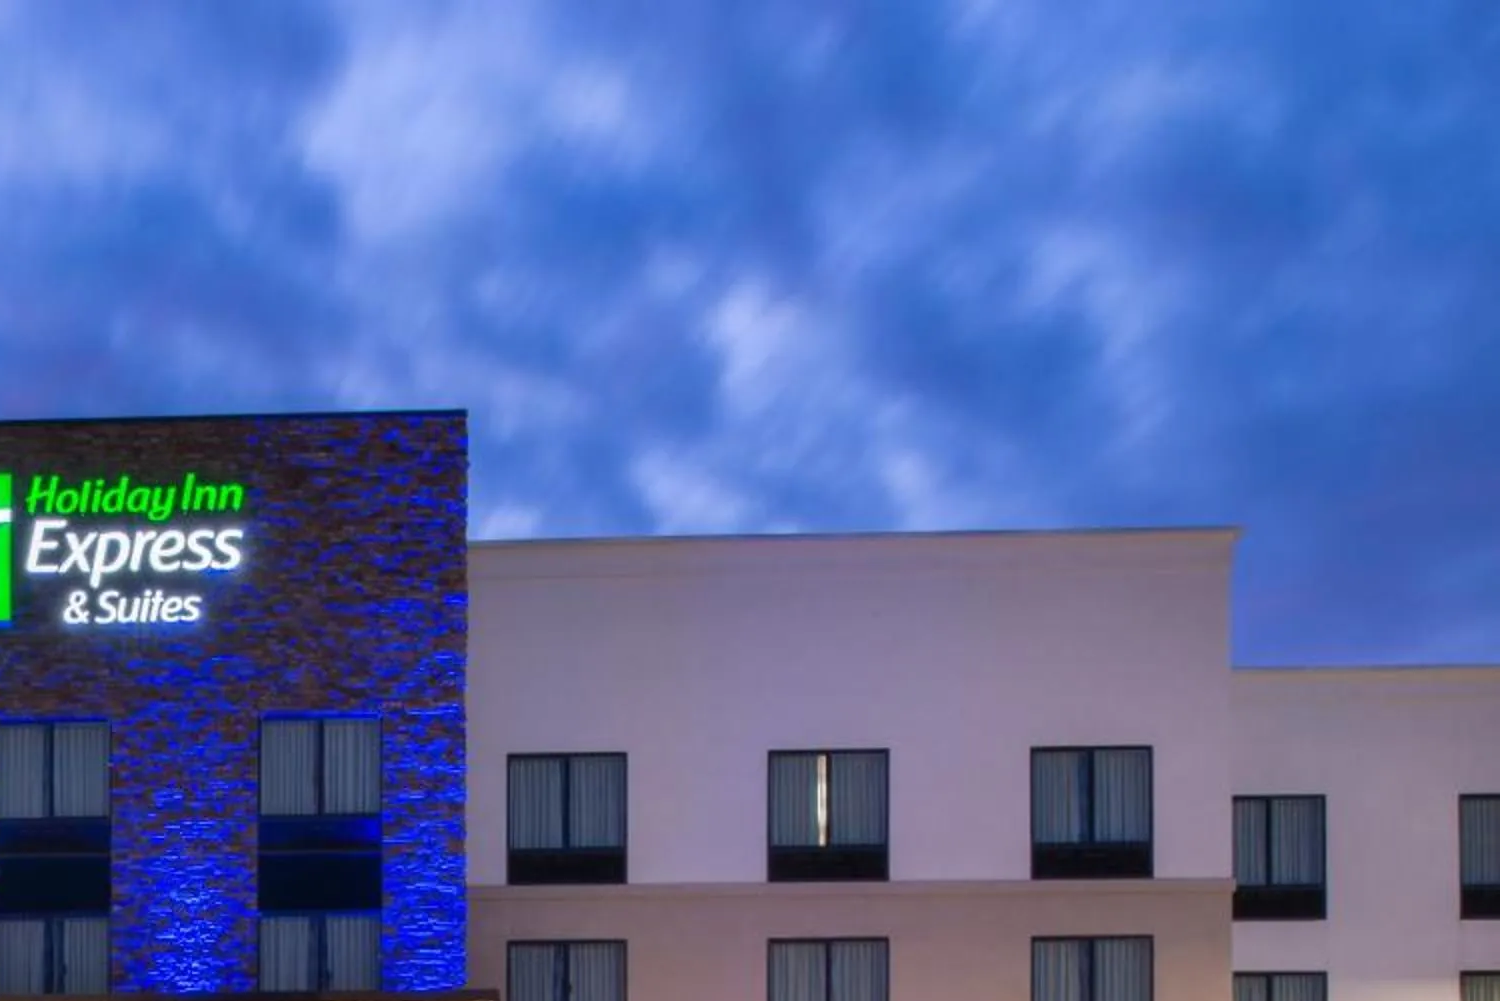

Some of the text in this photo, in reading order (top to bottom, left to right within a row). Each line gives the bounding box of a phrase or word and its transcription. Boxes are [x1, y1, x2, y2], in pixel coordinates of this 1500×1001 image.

[25, 473, 243, 521] Holiday Inn
[25, 519, 243, 588] Express
[63, 590, 203, 625] & Suites
